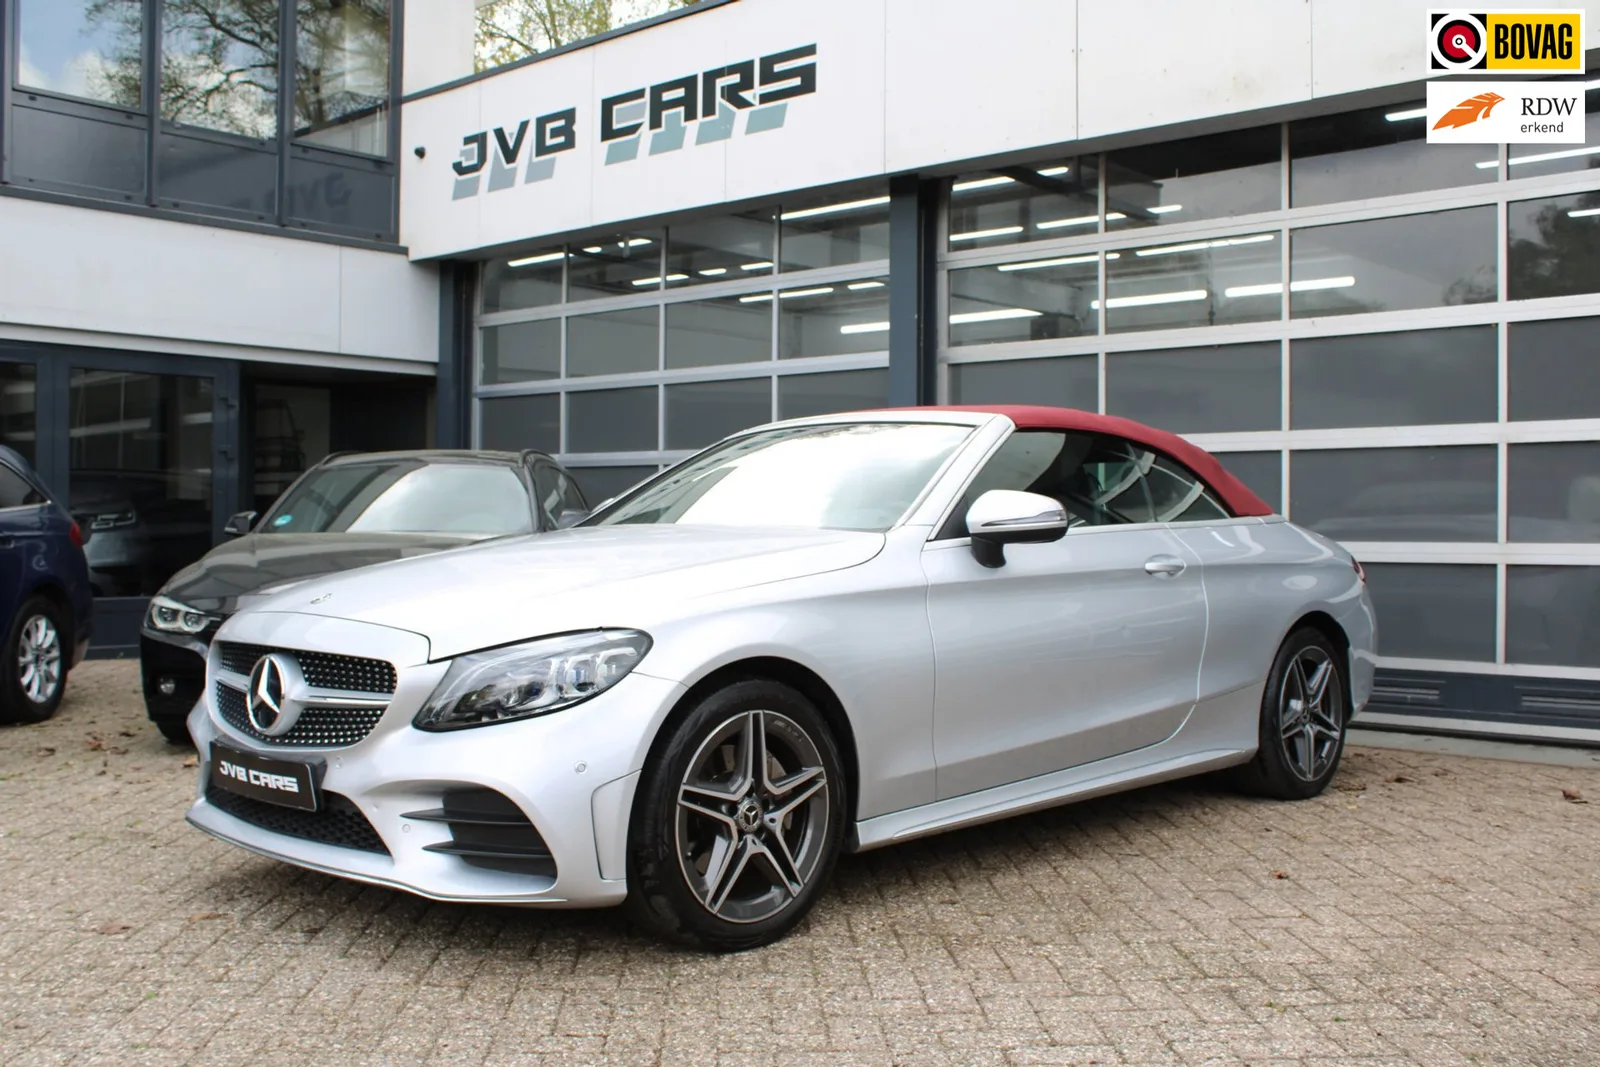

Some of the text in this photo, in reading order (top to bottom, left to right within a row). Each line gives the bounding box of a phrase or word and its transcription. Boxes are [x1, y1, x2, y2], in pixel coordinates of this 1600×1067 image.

[452, 43, 817, 176] JVB CARS
[219, 760, 299, 792] JVB CARS
